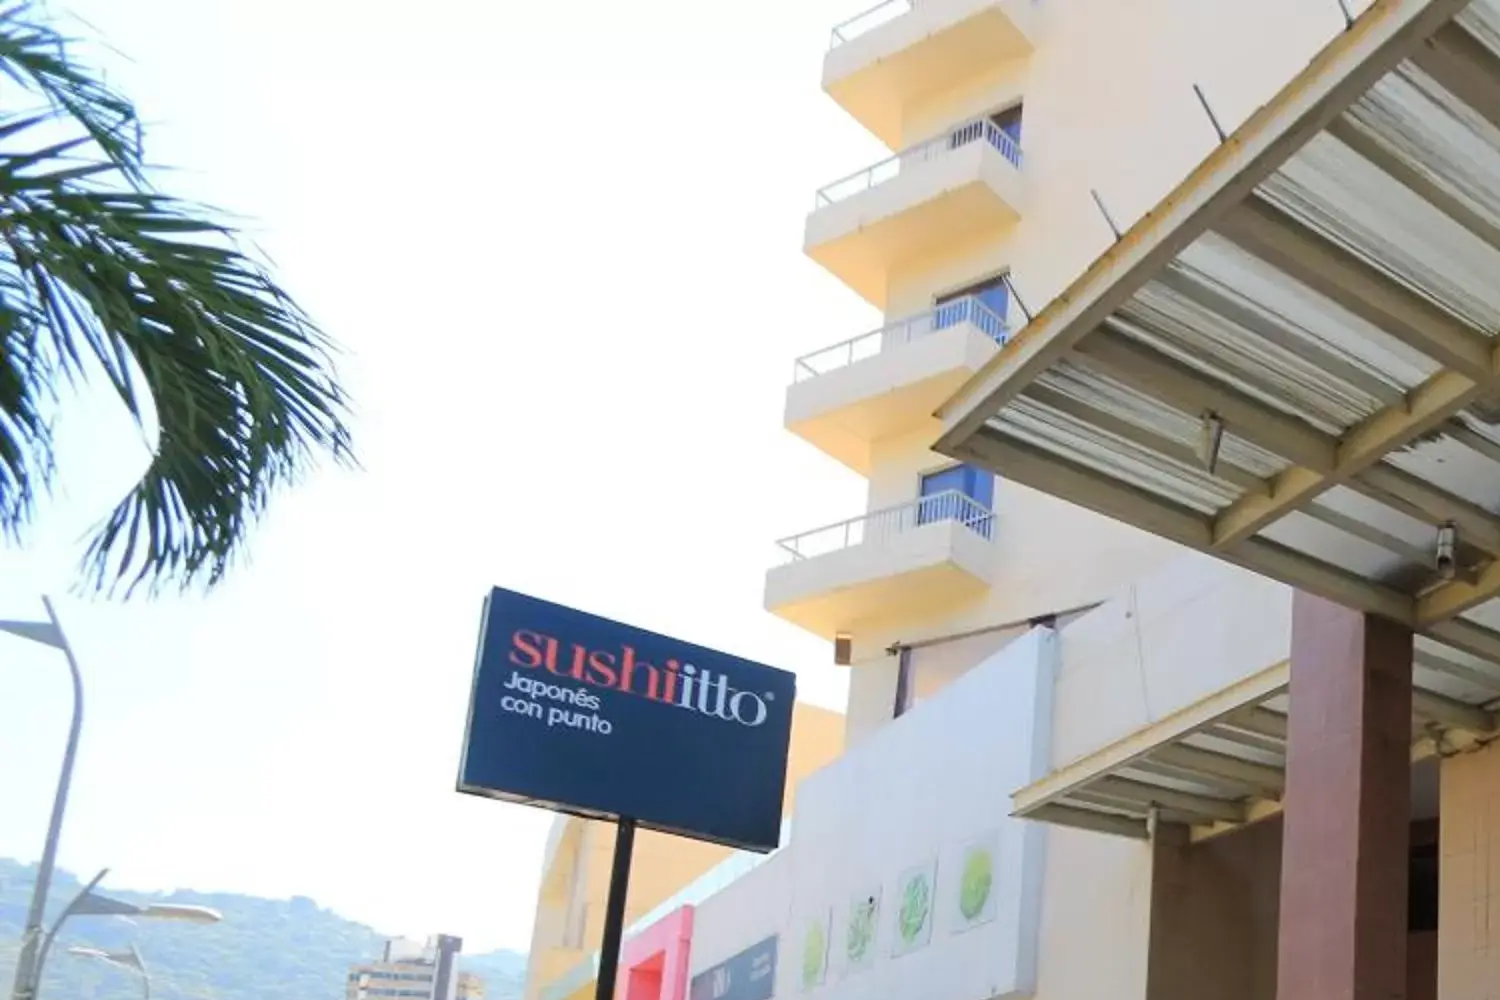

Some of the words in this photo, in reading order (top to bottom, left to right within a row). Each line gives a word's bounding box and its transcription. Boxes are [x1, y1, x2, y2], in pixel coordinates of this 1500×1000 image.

[503, 671, 601, 710] Japonés
[508, 628, 768, 727] sushiitto
[501, 696, 543, 719] con
[547, 707, 613, 734] punto
